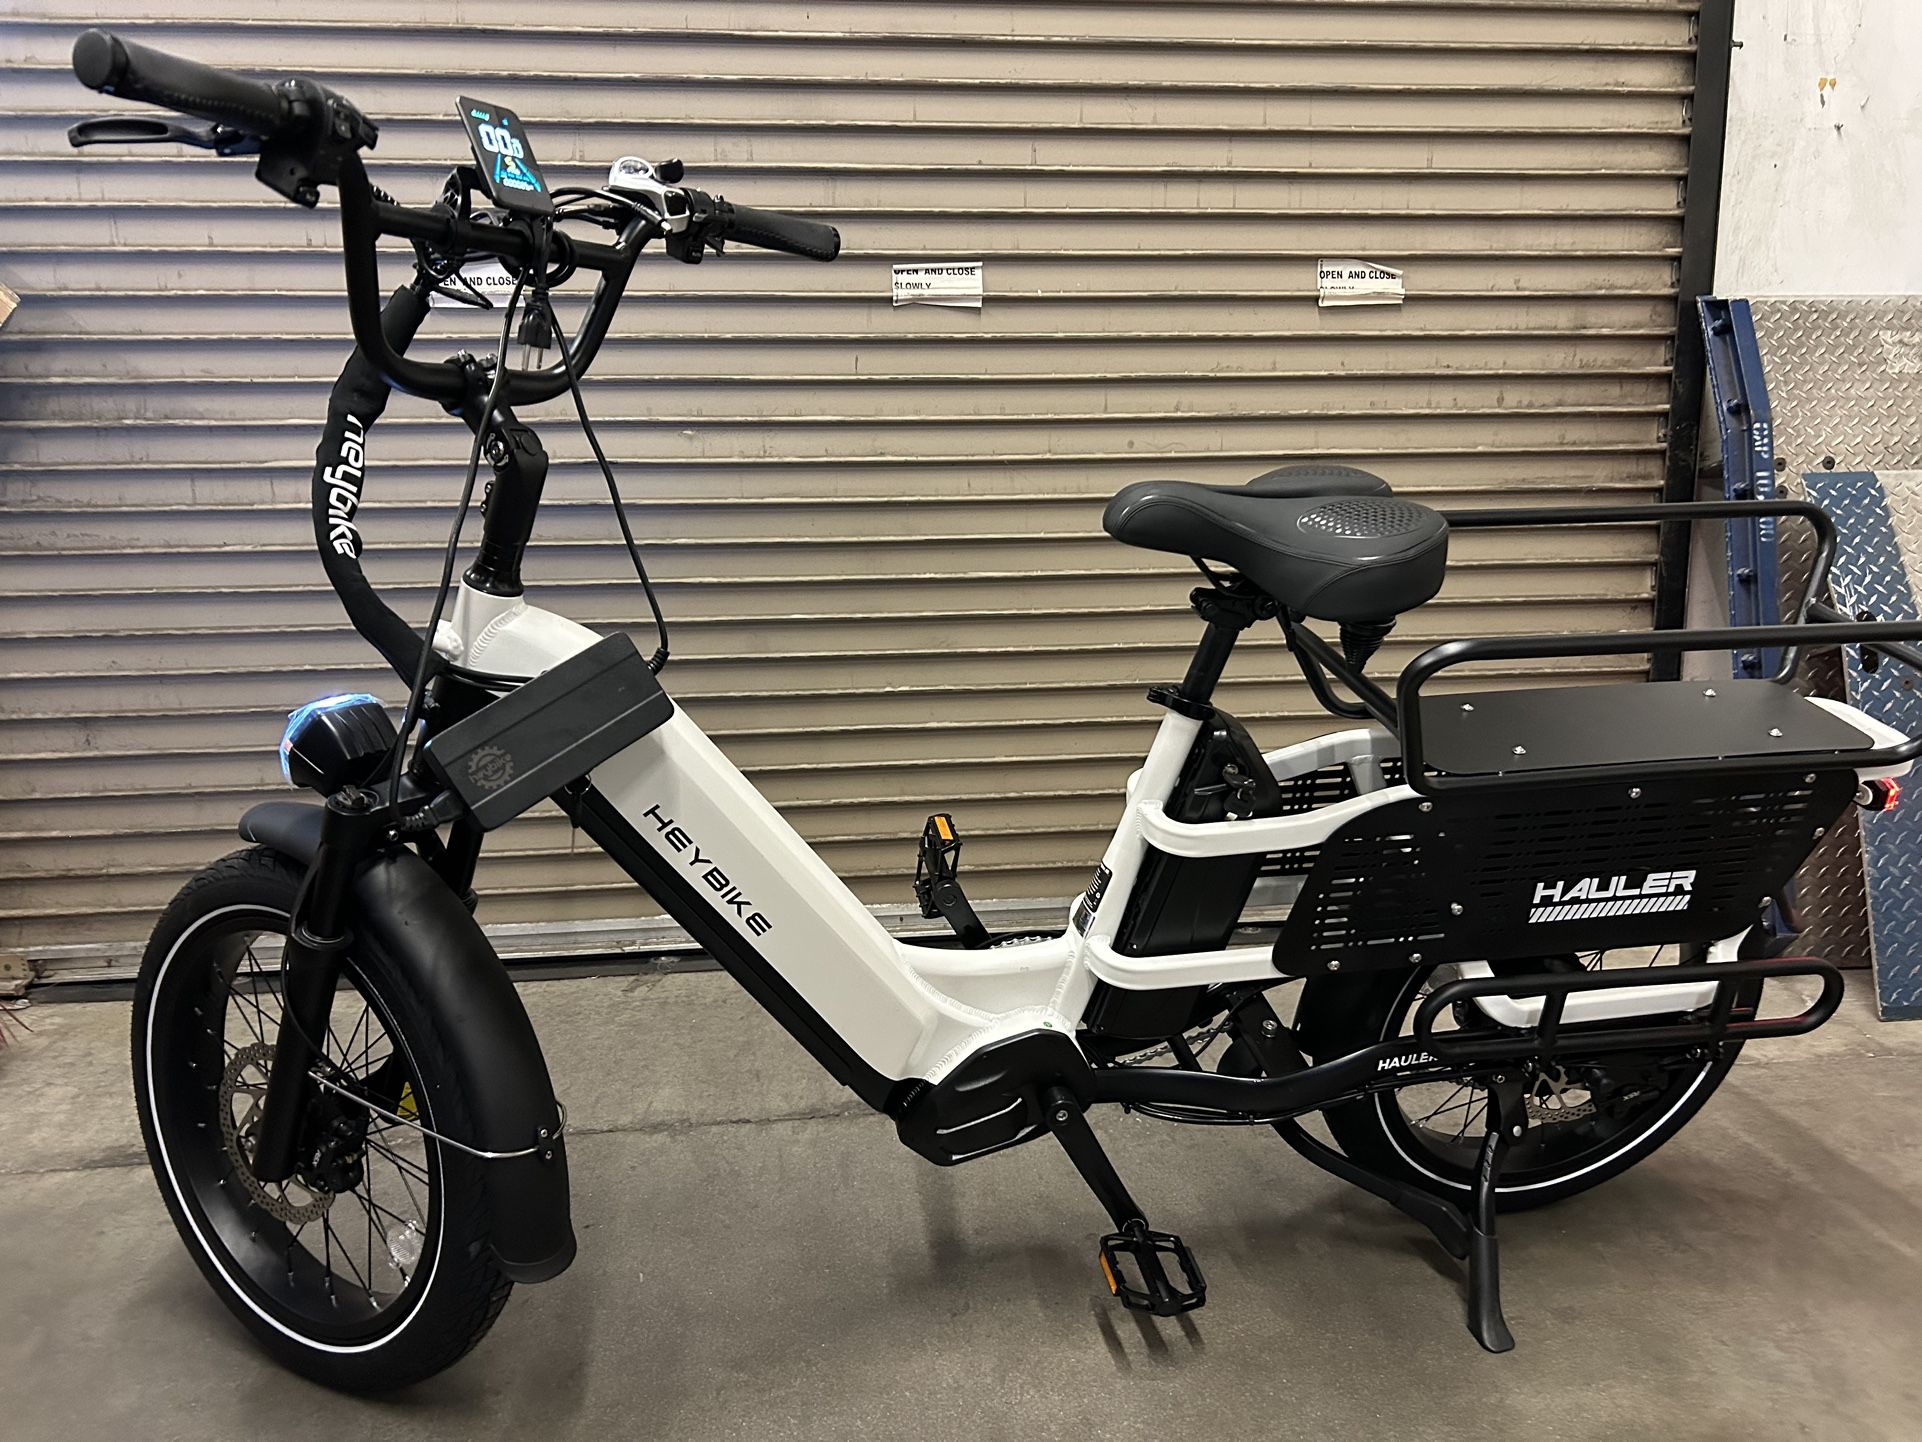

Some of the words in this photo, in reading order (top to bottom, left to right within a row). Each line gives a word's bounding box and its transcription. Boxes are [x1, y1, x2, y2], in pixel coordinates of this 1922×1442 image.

[485, 276, 518, 287] CLOSE
[893, 268, 919, 276] OPEN
[924, 268, 944, 276] AND
[946, 267, 976, 276] CLOSE
[1319, 270, 1343, 280] OPEN
[1348, 270, 1366, 280] AND
[894, 281, 932, 290] SLOWLY
[1753, 422, 1770, 459] CAP
[1755, 471, 1775, 542] 10,00
[642, 803, 773, 937] HEYBIKE
[1532, 869, 1697, 904] HAULER
